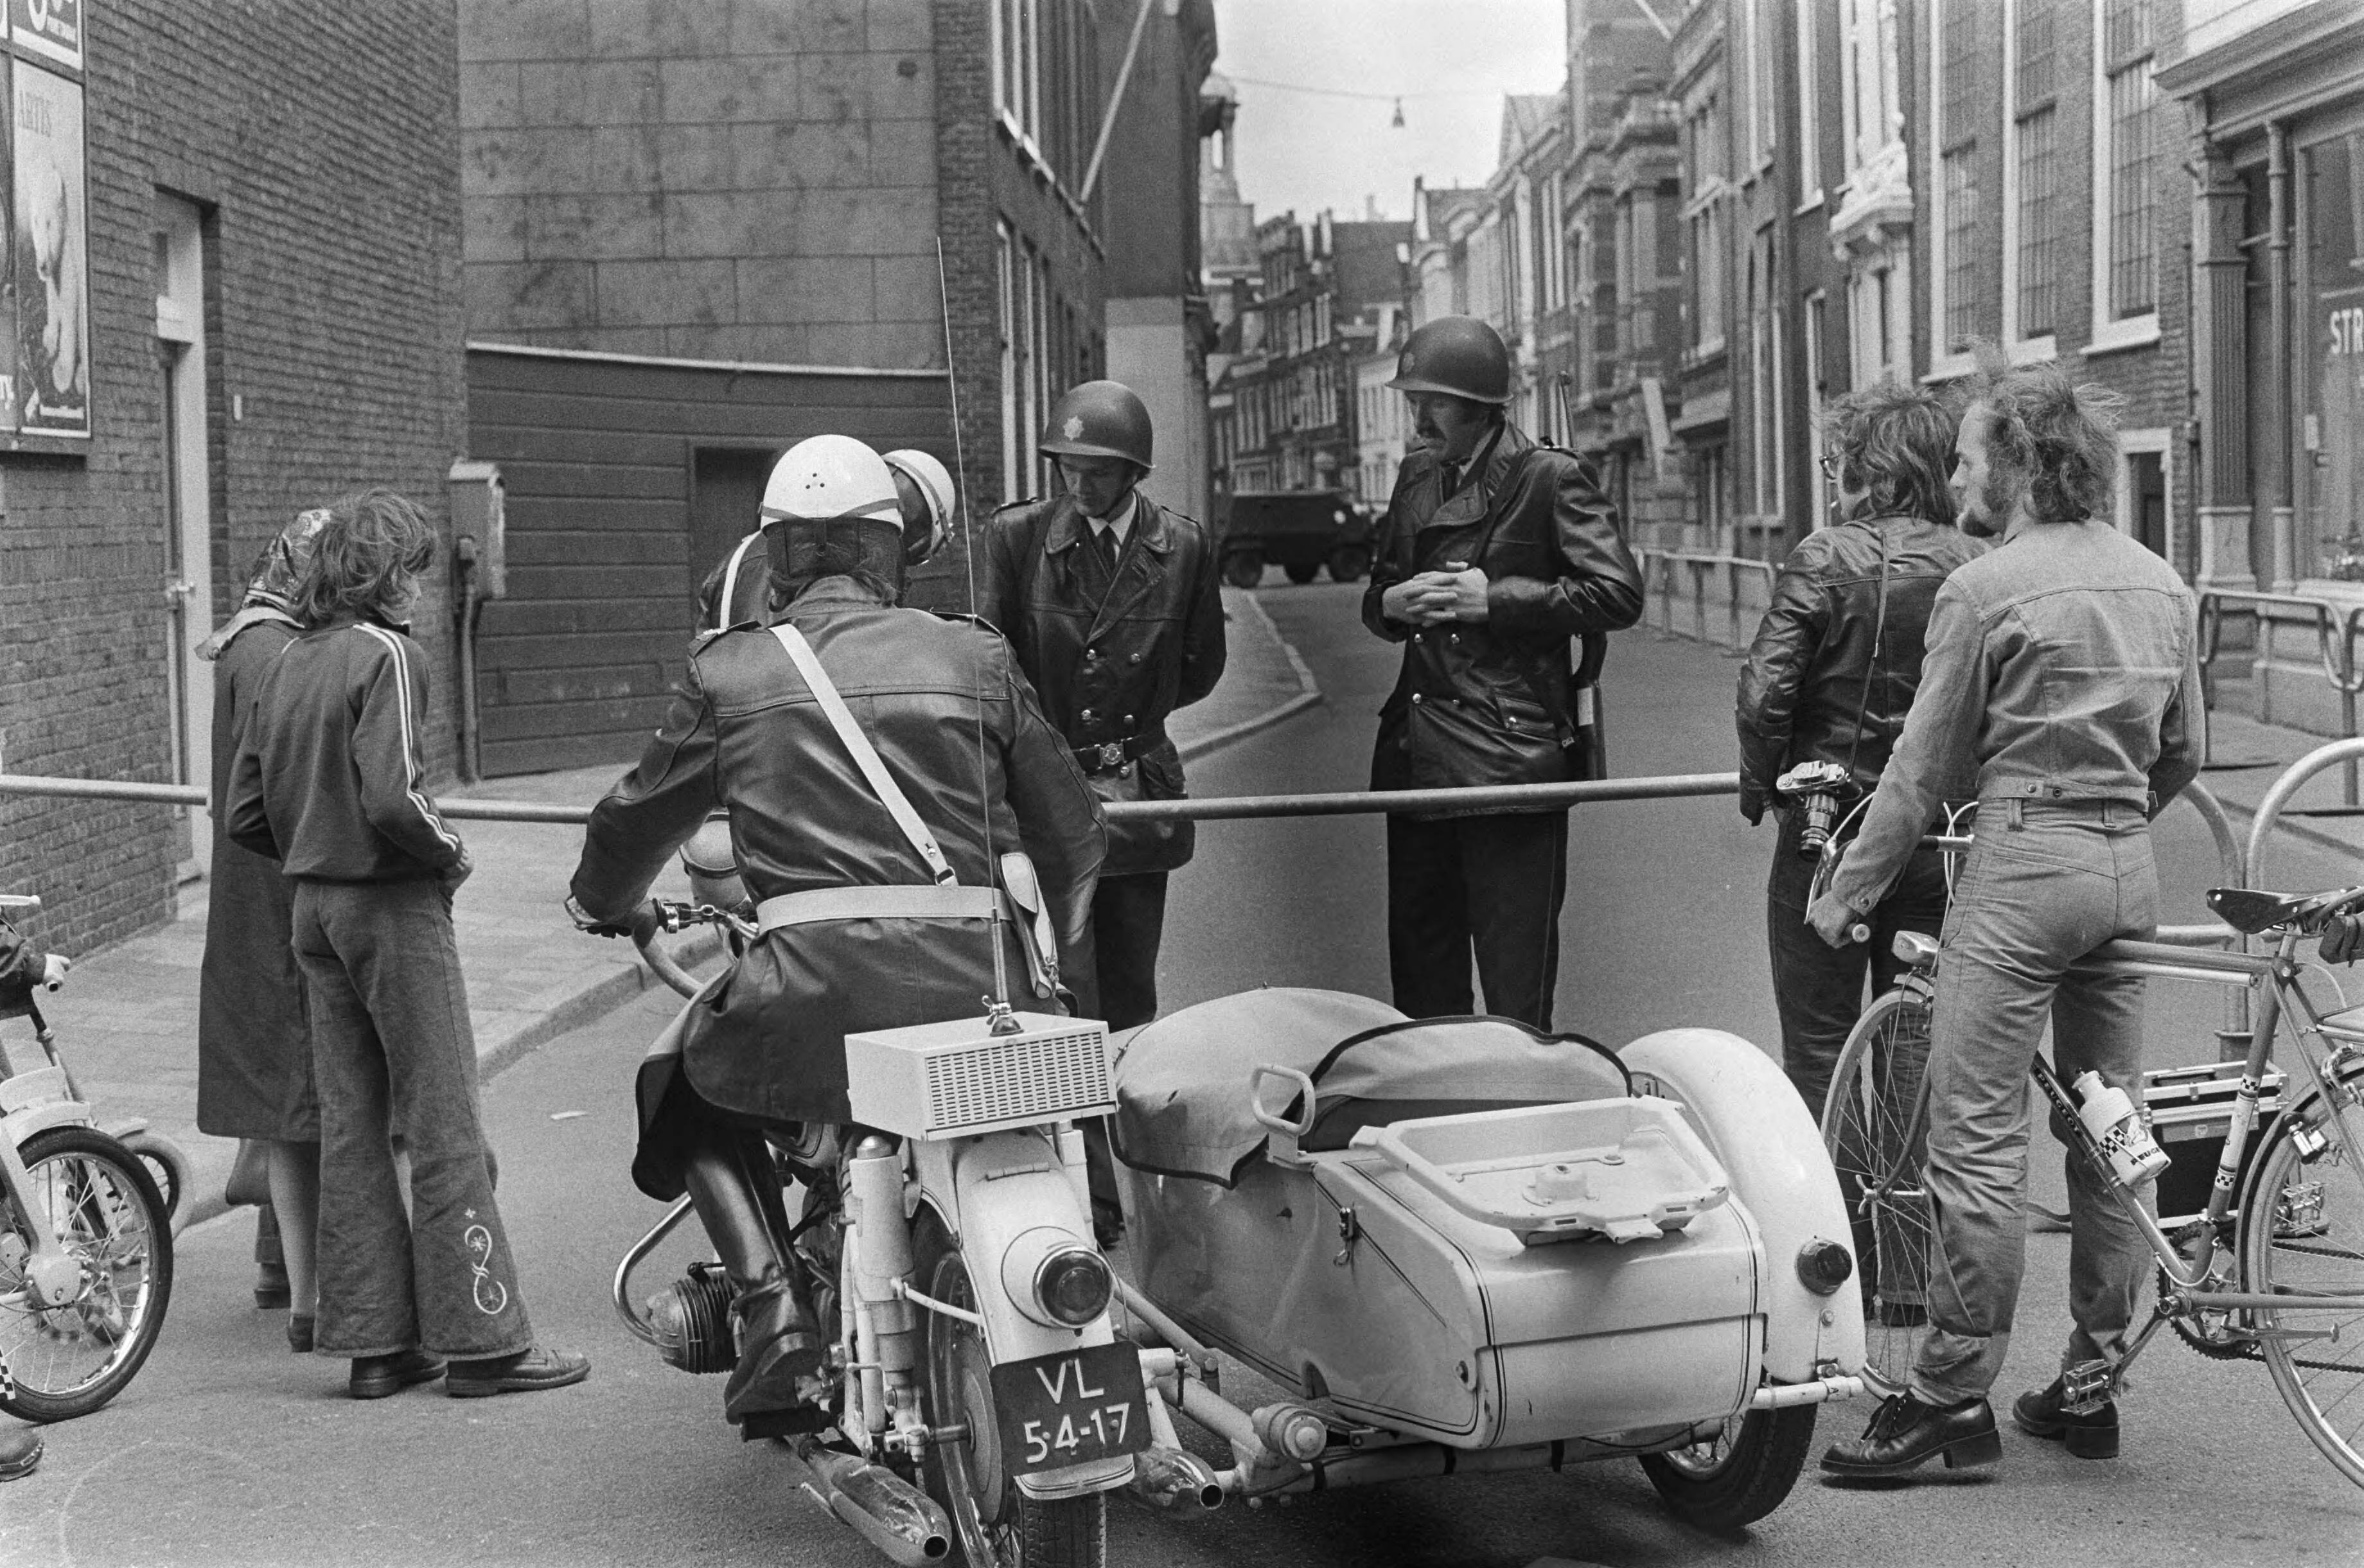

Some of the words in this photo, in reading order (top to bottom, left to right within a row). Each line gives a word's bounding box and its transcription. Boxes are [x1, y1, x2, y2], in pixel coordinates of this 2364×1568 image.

[2037, 1073, 2080, 1132] PEUGEOT
[1036, 1358, 1104, 1404] VL
[1023, 1402, 1130, 1464] 54-17
